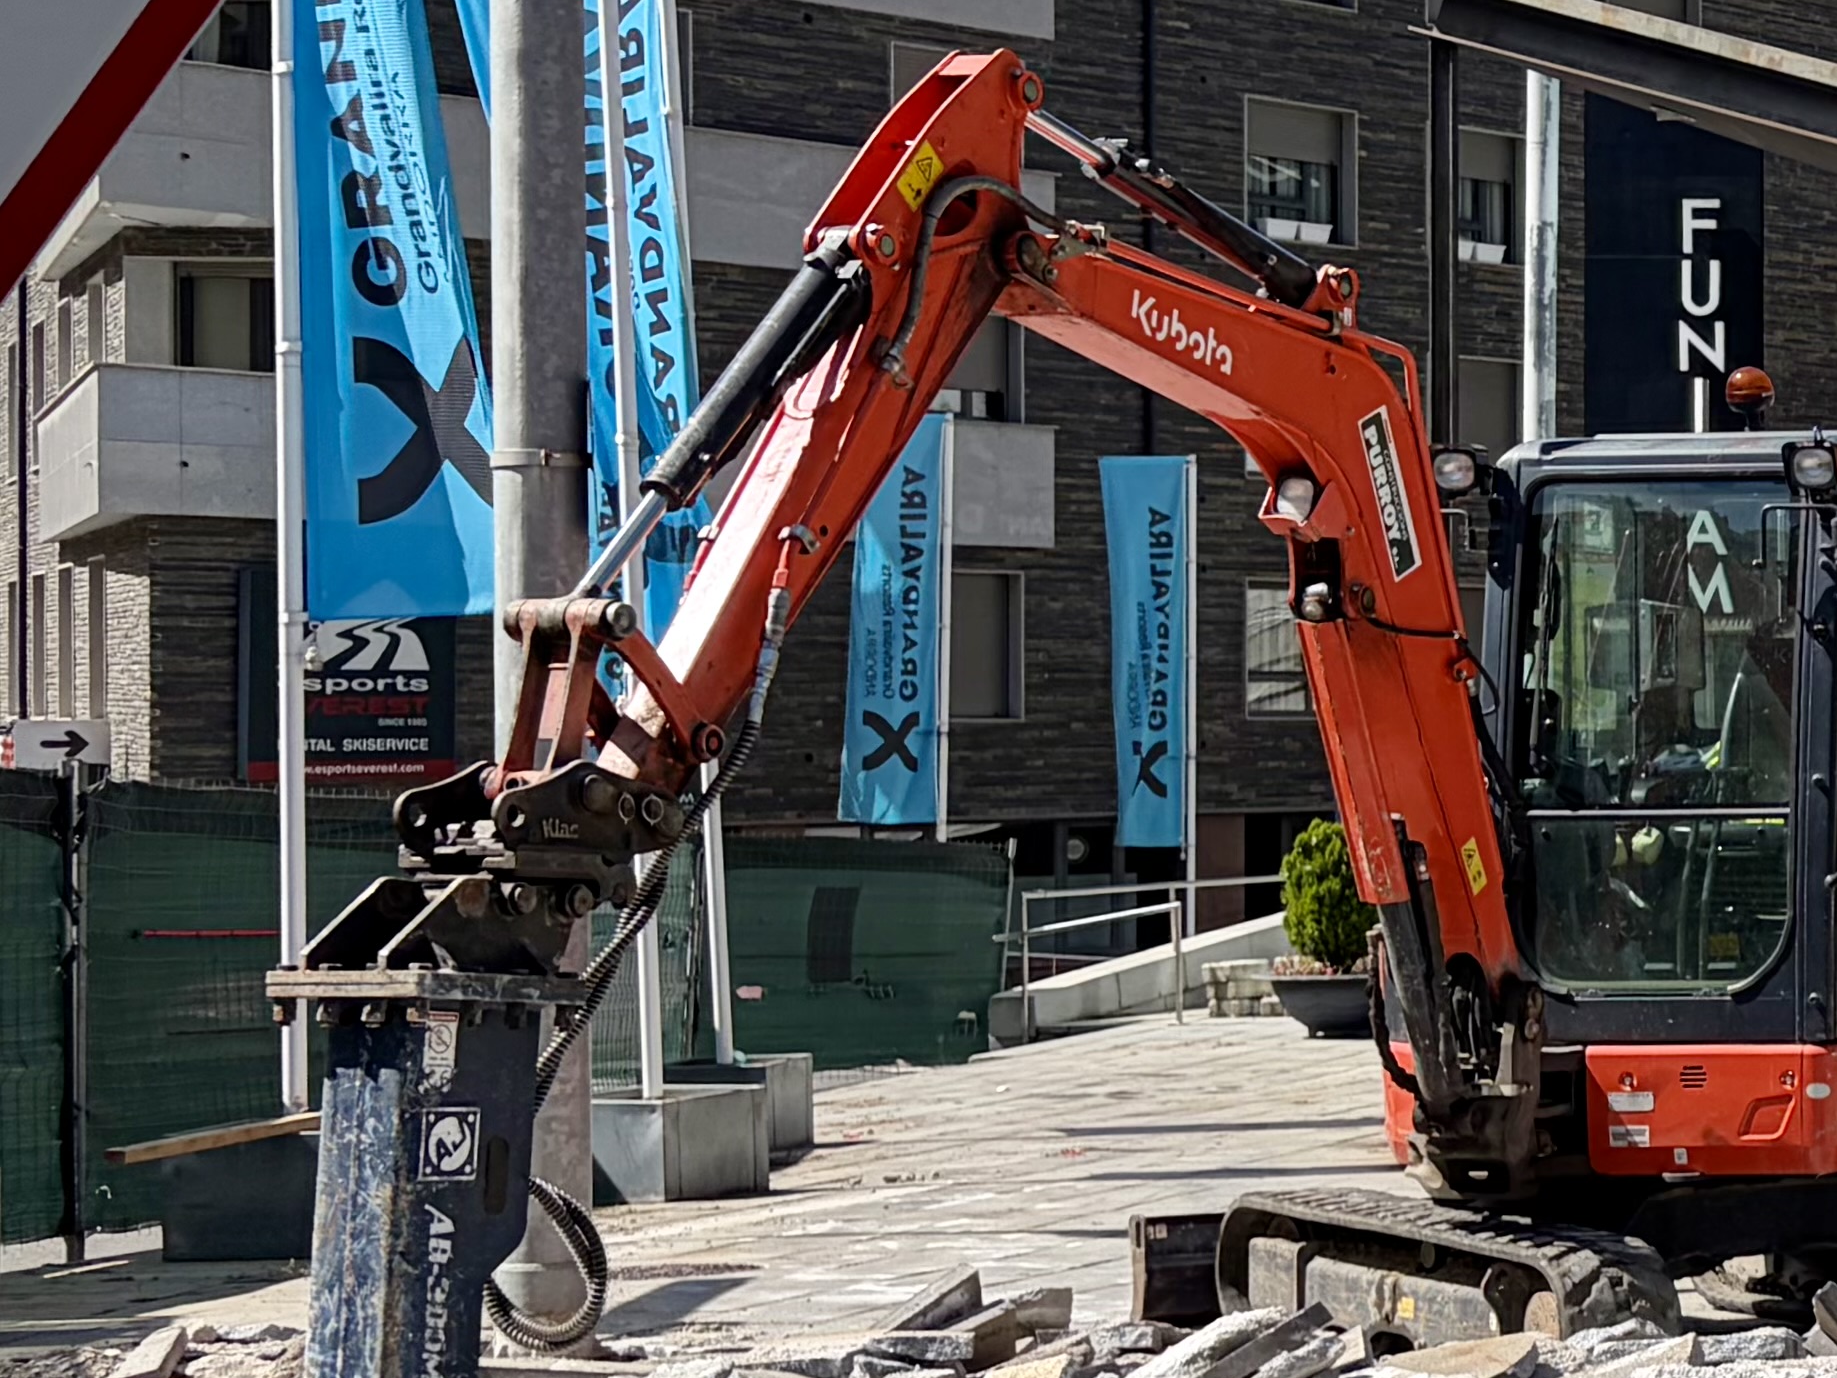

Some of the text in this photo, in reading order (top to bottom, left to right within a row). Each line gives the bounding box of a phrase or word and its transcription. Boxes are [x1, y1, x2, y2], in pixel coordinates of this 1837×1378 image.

[359, 48, 438, 294] Grandvalira
[1131, 288, 1233, 376] Kubota
[1364, 425, 1402, 541] PURROY
[303, 675, 429, 695] sports
[342, 737, 429, 752] SKISERVICE
